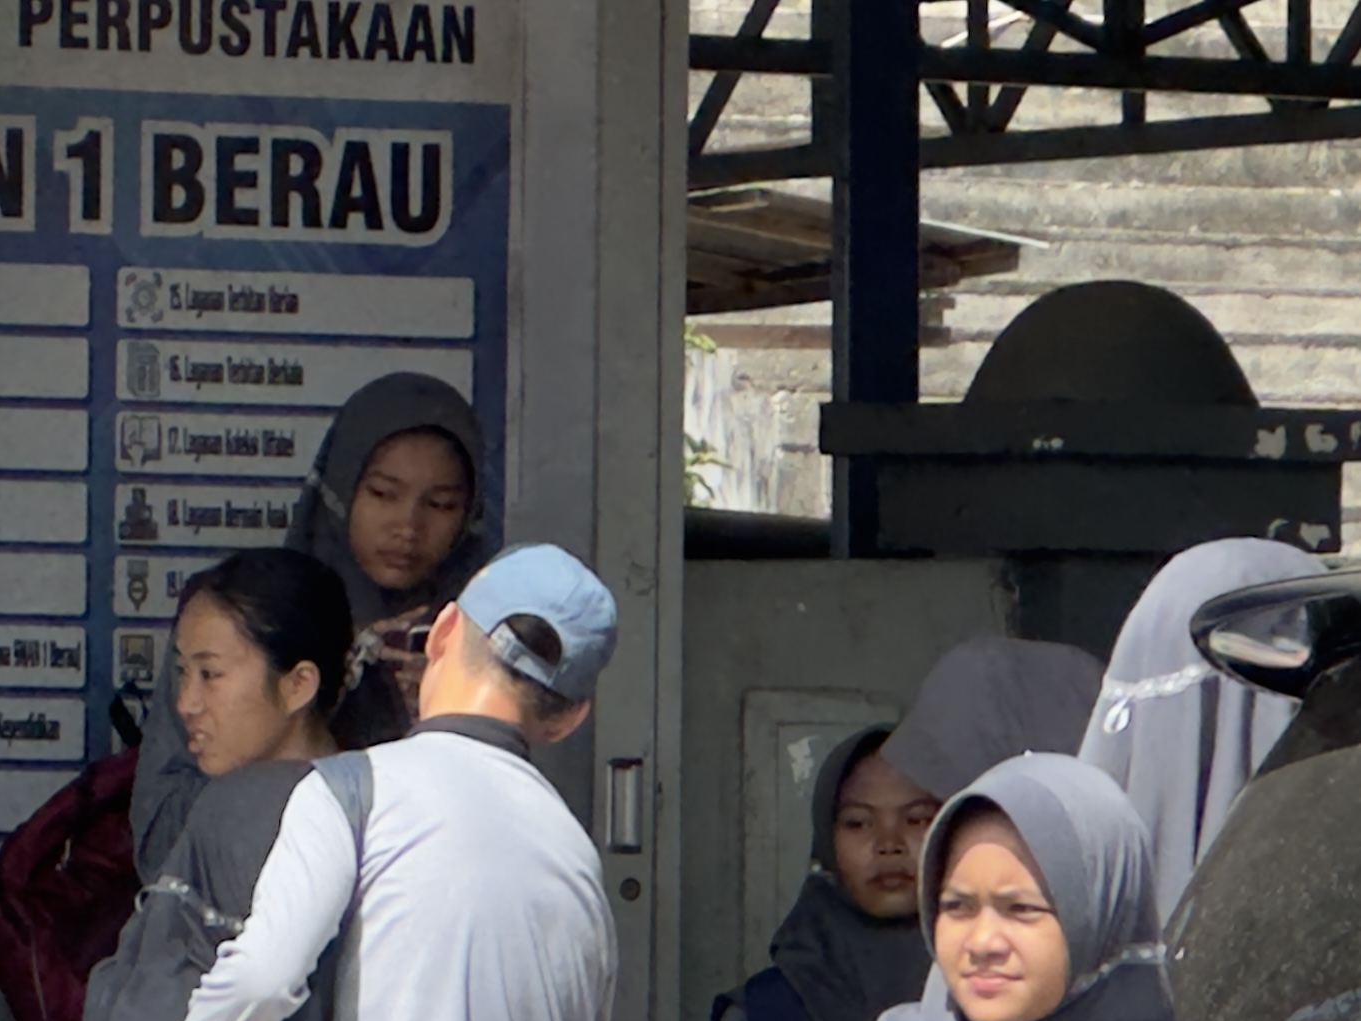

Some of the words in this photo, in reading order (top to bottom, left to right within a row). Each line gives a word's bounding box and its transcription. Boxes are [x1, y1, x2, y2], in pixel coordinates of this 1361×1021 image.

[18, 0, 475, 64] PERPUSTAKAAN
[66, 130, 101, 220] 1
[152, 133, 440, 233] BERAU
